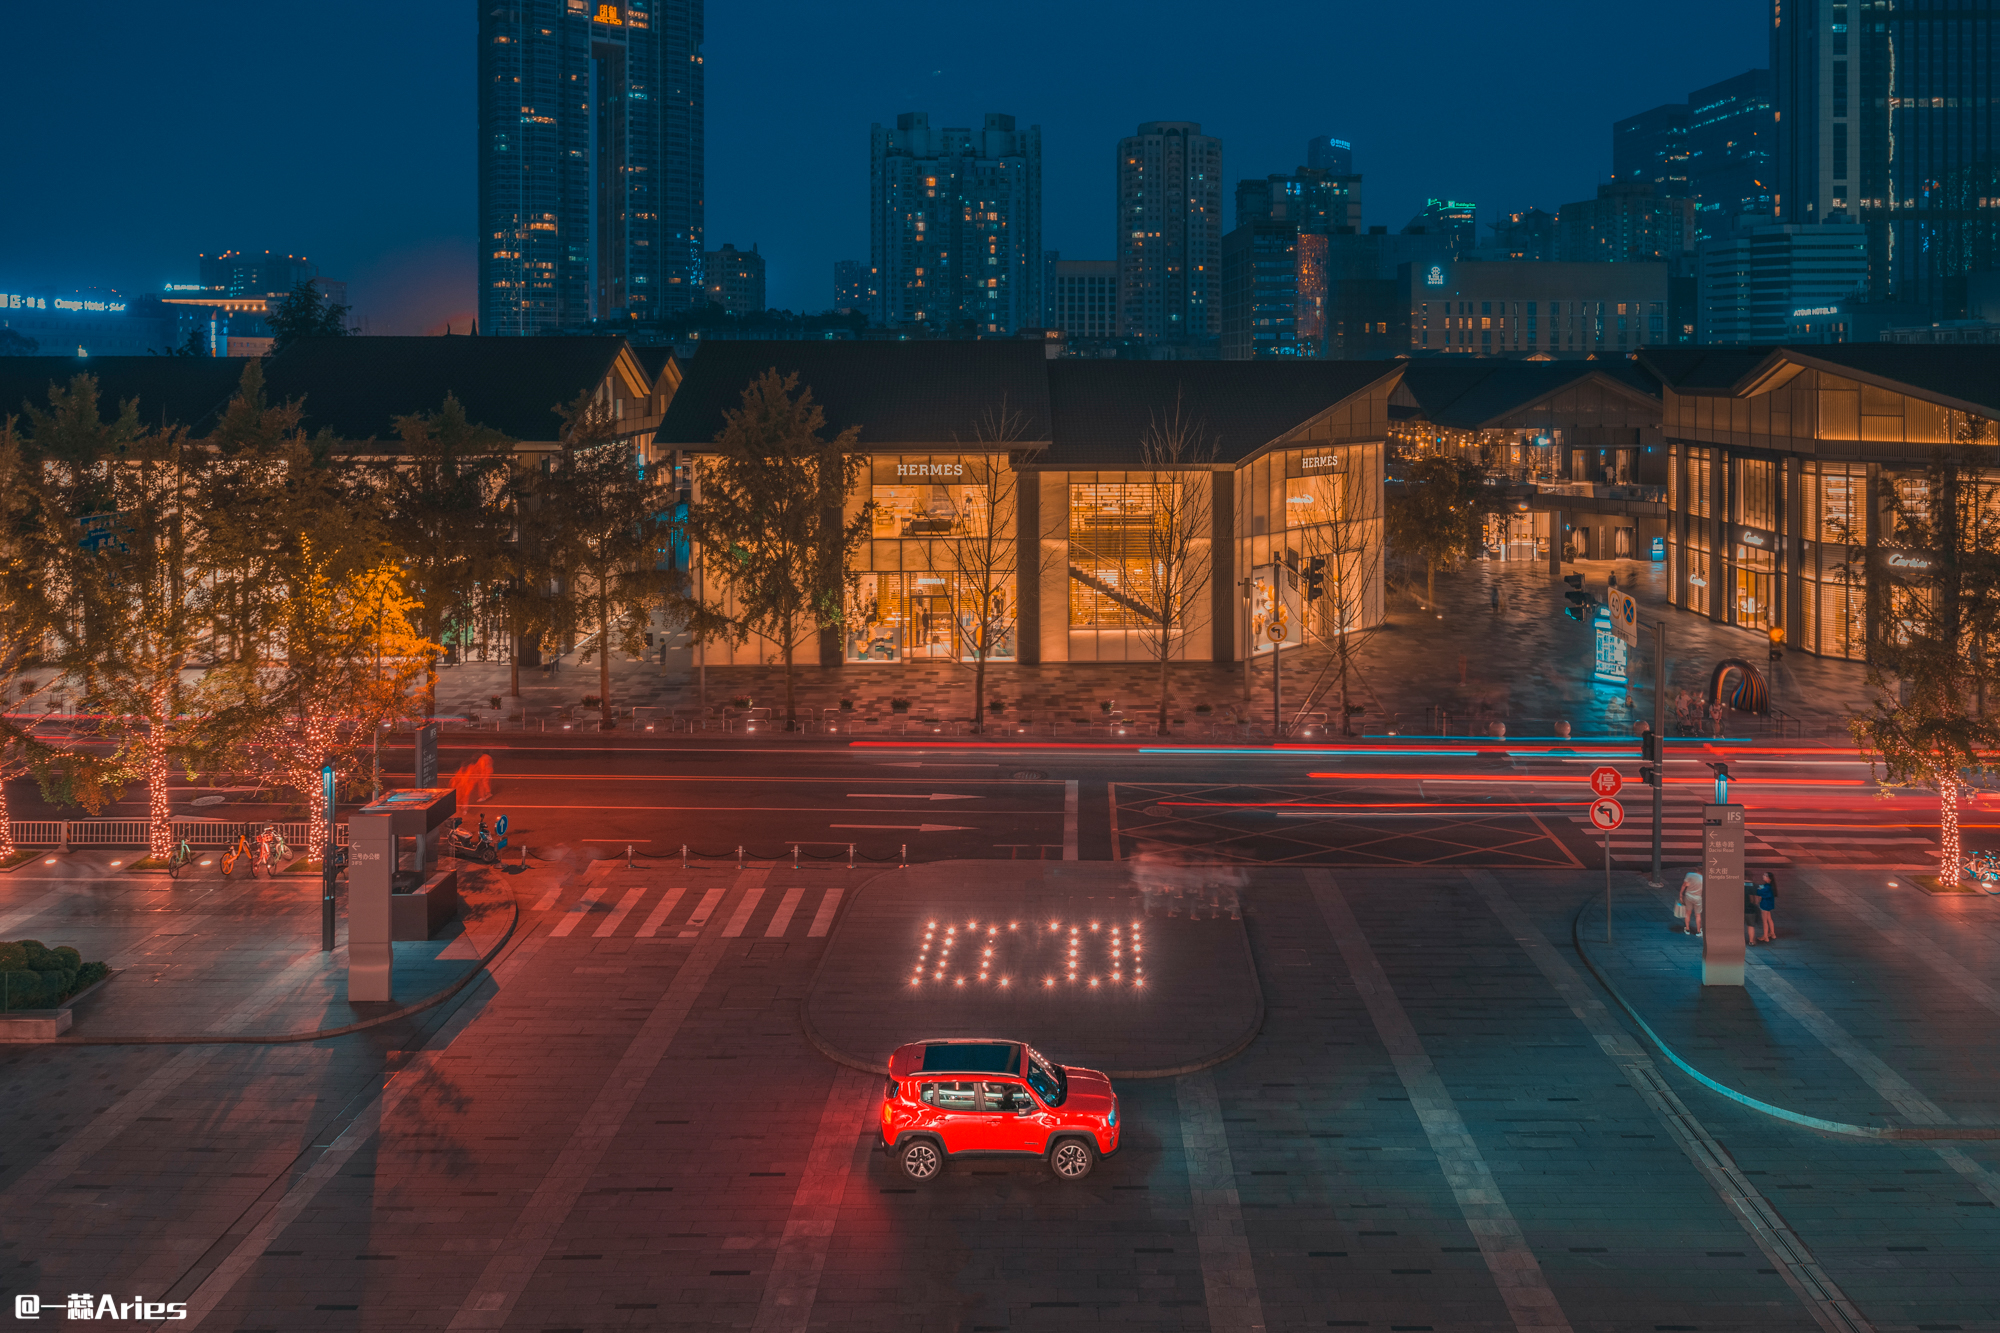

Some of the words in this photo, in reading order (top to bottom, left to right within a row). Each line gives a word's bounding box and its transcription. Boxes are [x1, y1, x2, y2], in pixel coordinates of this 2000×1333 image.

[1611, 597, 1619, 612] 40
[1596, 772, 1616, 791] 停
[1727, 811, 1741, 821] IFS
[351, 852, 380, 860] 三号办公楼
[1708, 867, 1728, 875] 东大街
